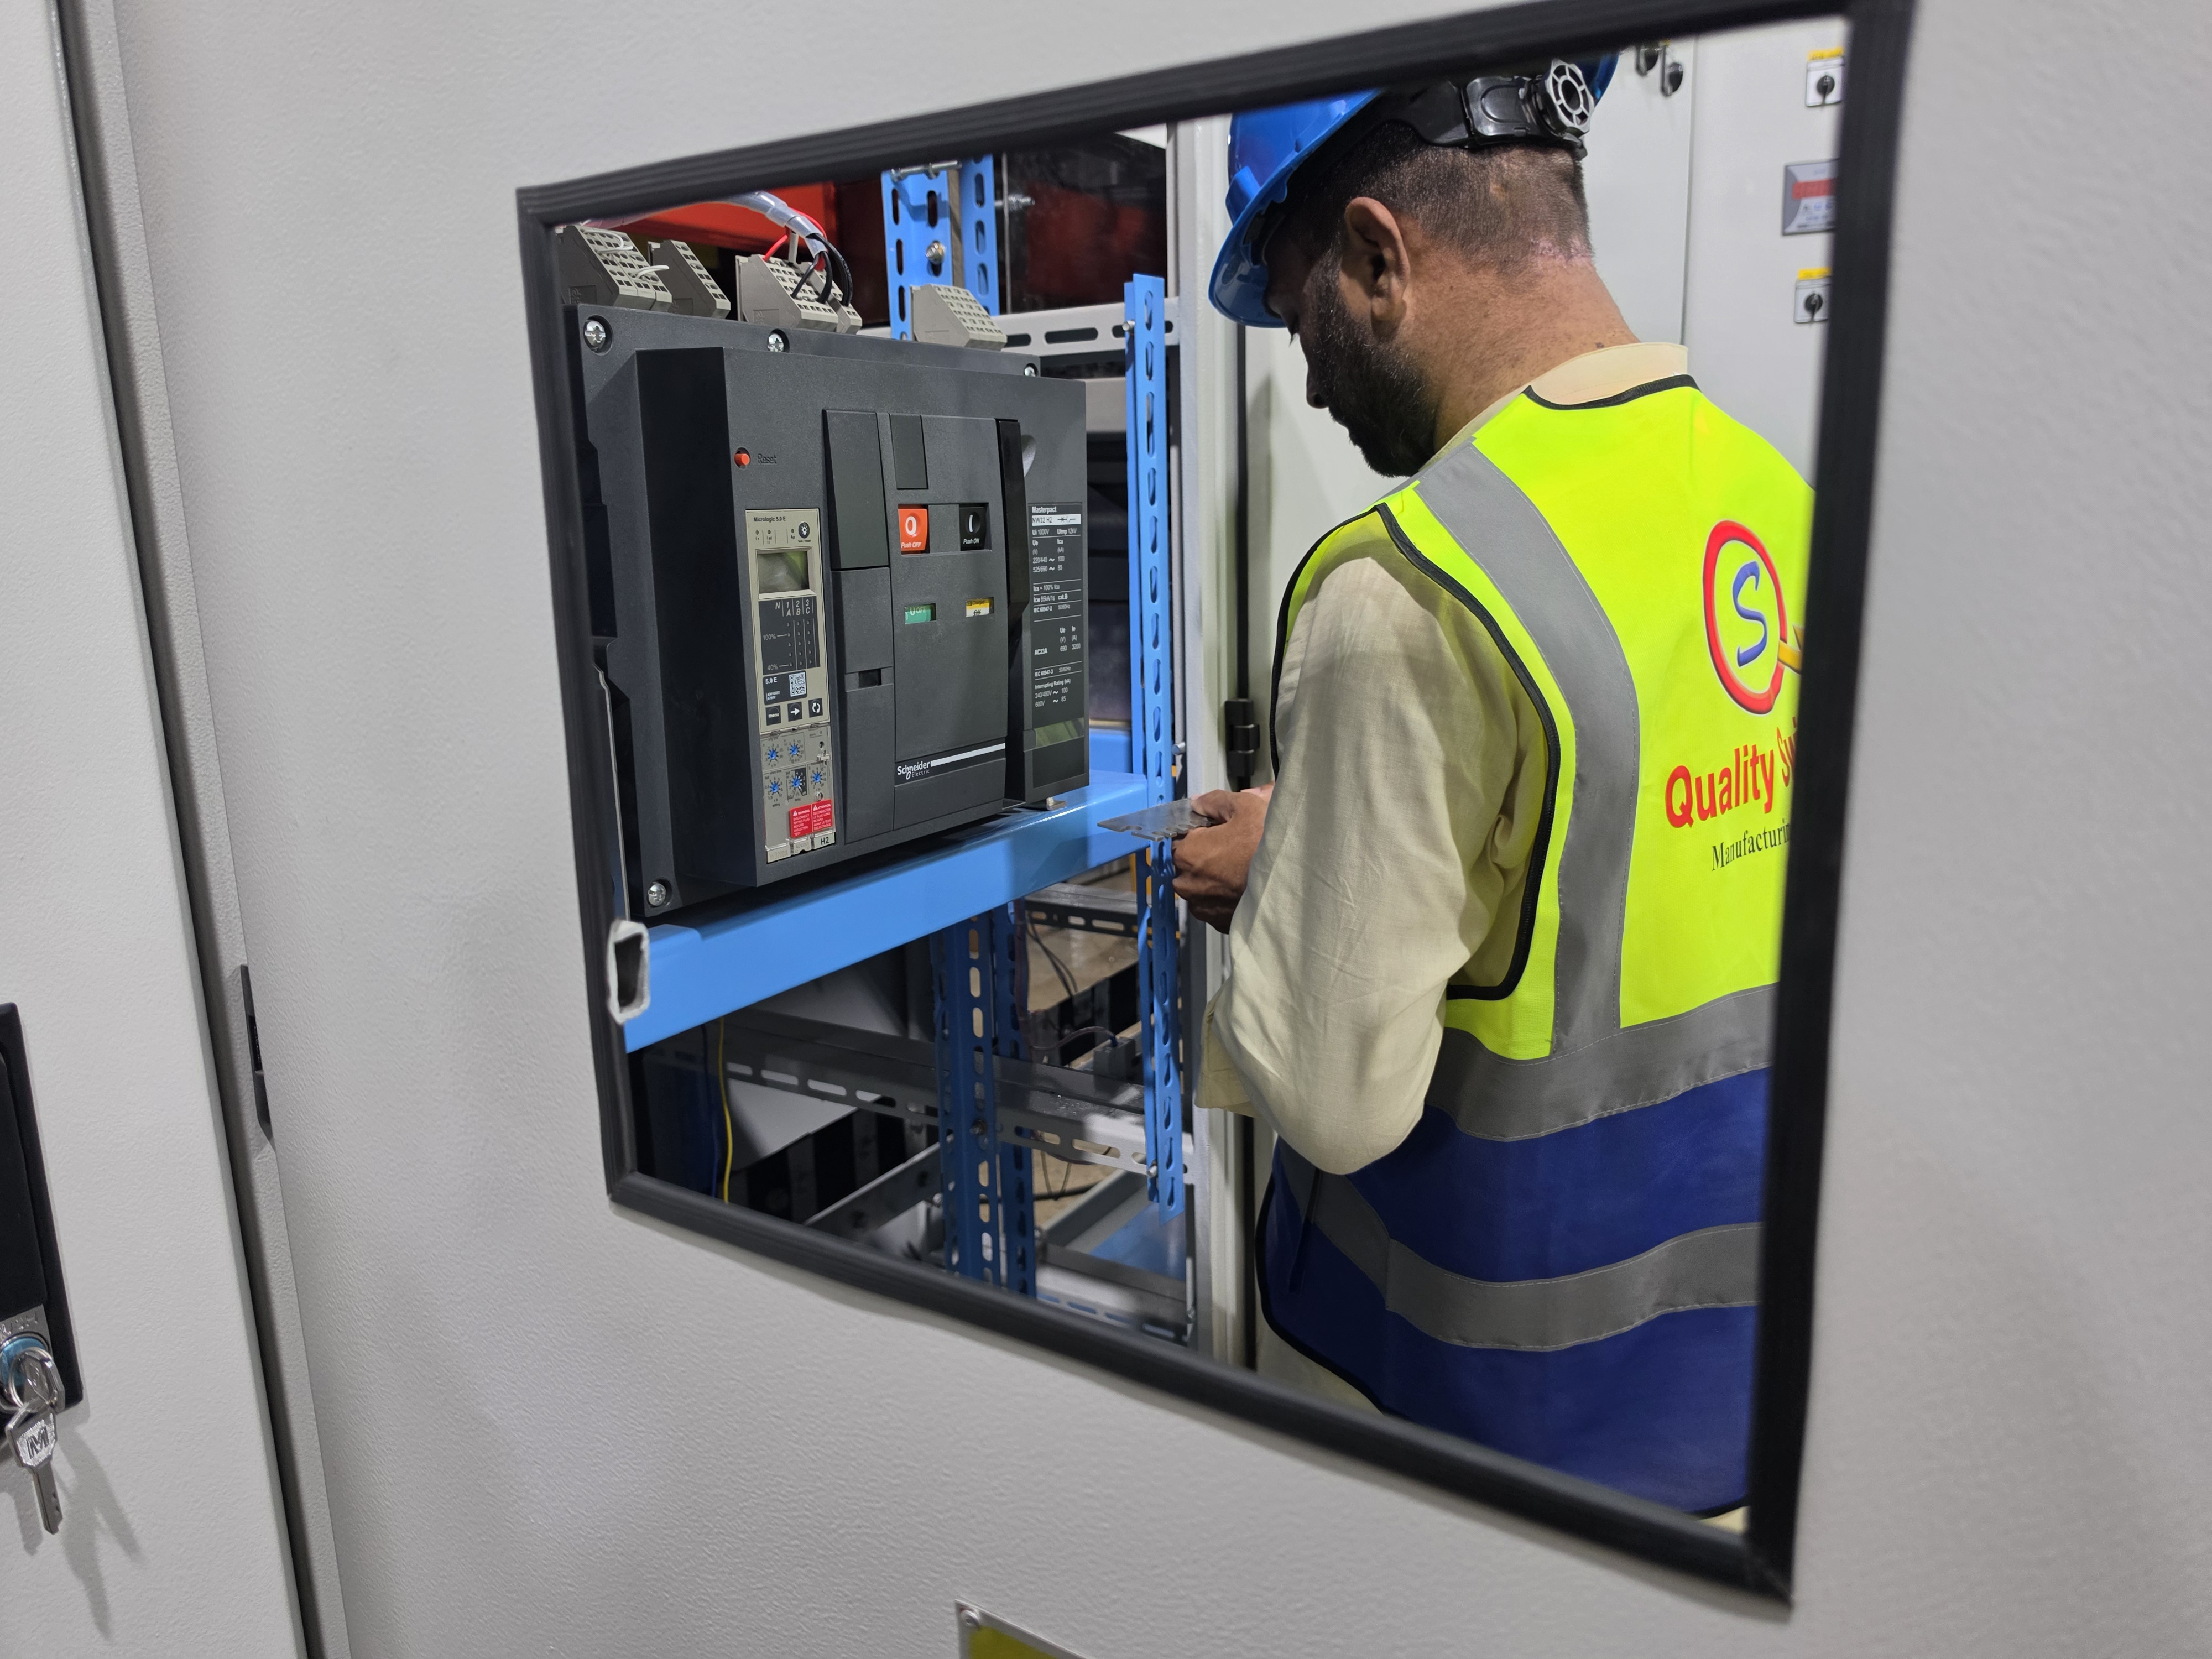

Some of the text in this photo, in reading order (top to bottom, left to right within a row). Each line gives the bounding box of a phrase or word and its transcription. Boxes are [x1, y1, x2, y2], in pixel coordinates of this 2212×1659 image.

[758, 453, 777, 465] Reset
[1032, 506, 1057, 514] Masterpact
[1034, 647, 1048, 656] AC23A
[1035, 700, 1045, 708] 600V
[897, 760, 930, 775] Schneider
[911, 769, 930, 778] Electric
[1665, 744, 1775, 828] Quality
[820, 836, 830, 846] H2
